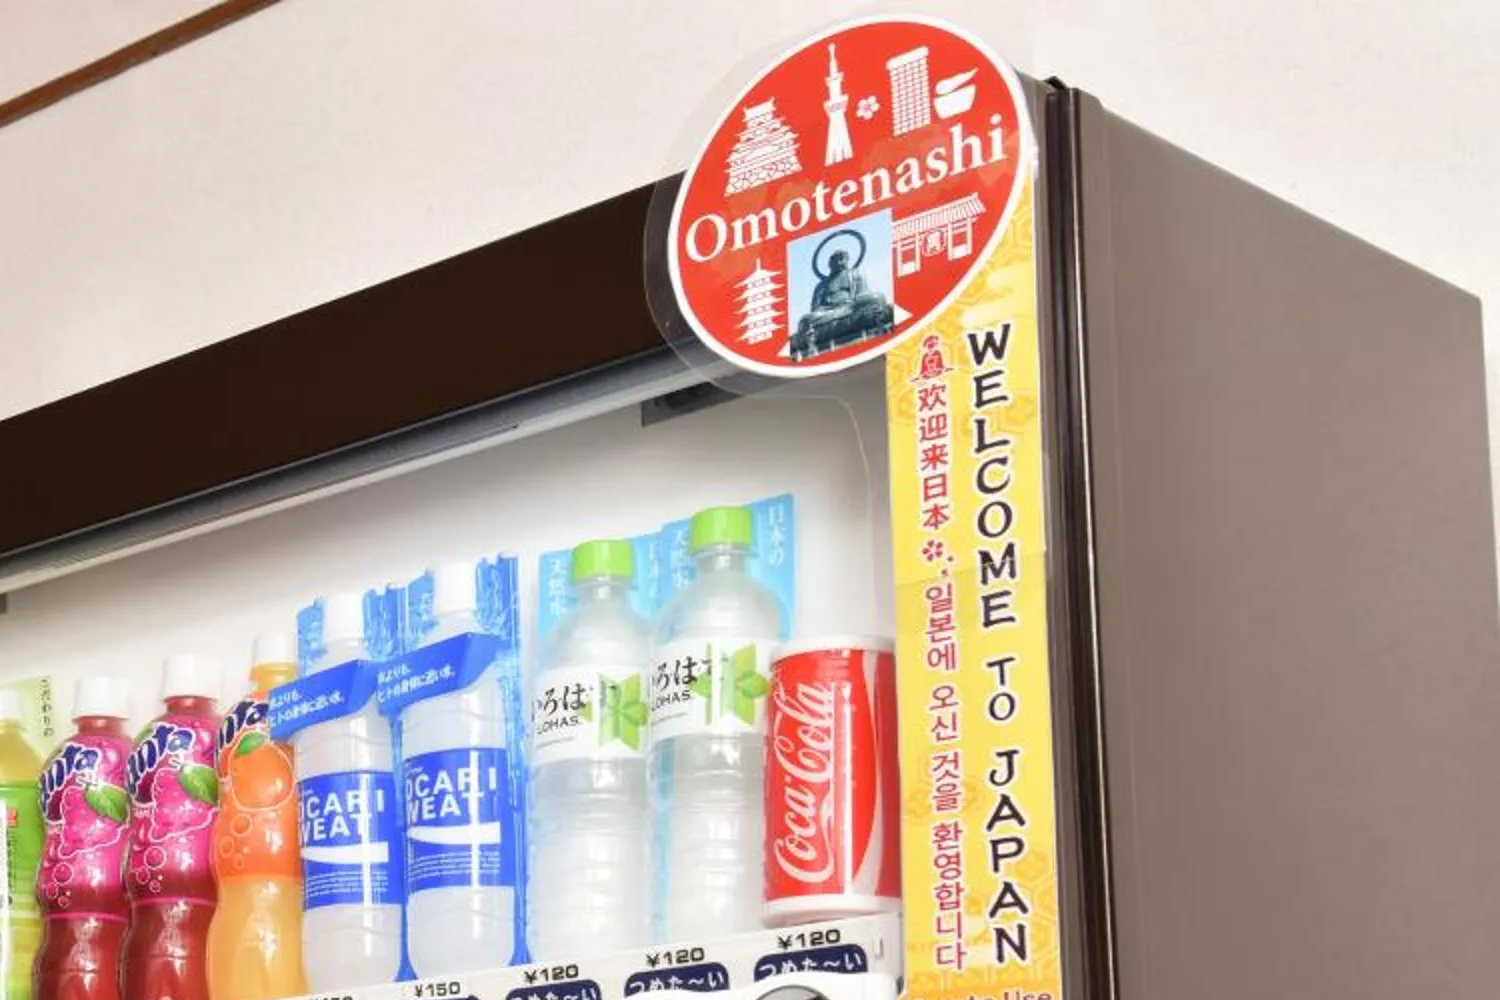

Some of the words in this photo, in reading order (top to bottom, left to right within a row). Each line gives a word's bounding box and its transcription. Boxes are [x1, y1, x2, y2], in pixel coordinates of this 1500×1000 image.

[685, 113, 1008, 264] Omotenashi
[918, 384, 949, 530] 欢迎来日本
[967, 323, 1017, 628] WELCOME
[926, 583, 956, 670] 일본에
[929, 685, 959, 742] 오신
[987, 657, 1016, 721] TO
[773, 667, 845, 884] Coca-Cola
[933, 752, 959, 810] 것을
[986, 749, 1029, 963] JAPAN
[933, 822, 967, 970] 환영합니다
[524, 964, 579, 983] ¥120
[646, 947, 705, 967] ¥120
[777, 929, 841, 950] ¥120
[414, 982, 461, 998] ¥150
